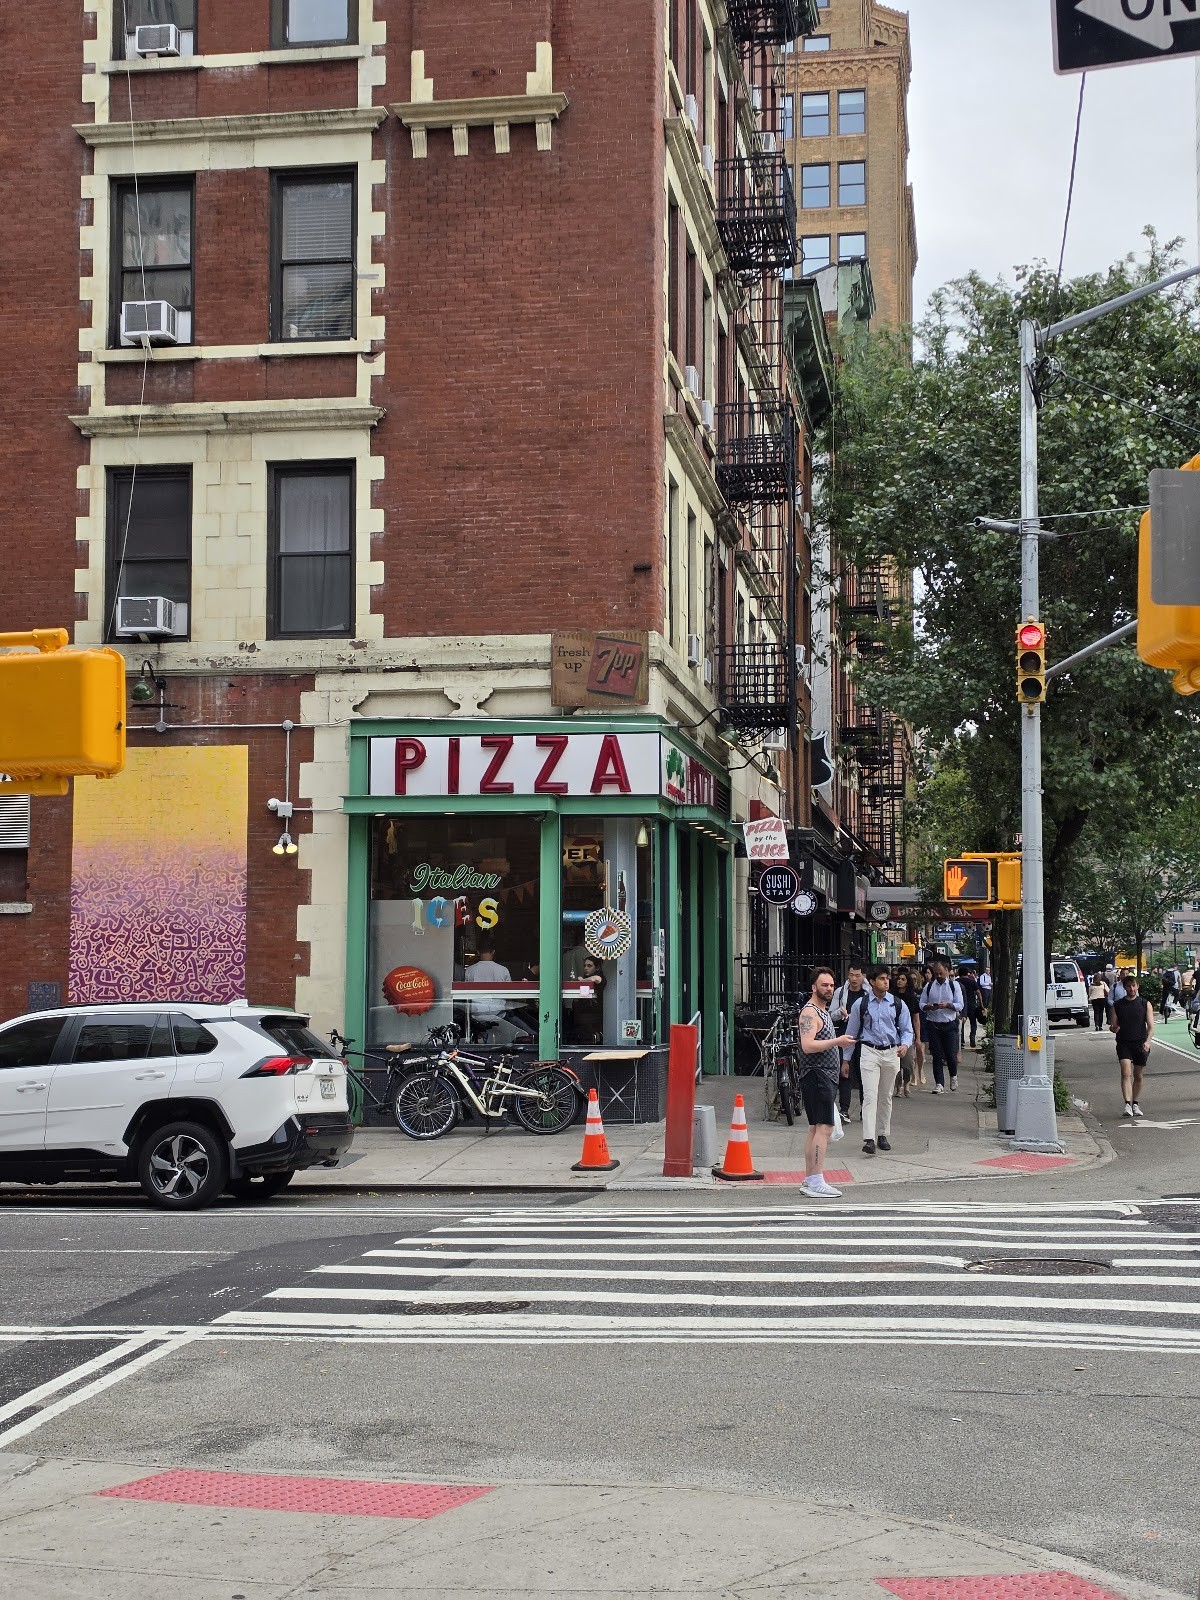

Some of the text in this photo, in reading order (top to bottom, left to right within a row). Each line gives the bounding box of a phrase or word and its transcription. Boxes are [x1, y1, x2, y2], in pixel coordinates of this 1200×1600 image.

[394, 735, 631, 795] PIZZA
[745, 820, 783, 836] PIZZA
[749, 843, 786, 858] SLICE
[409, 863, 501, 892] Italian
[766, 875, 791, 889] SUSHI
[411, 896, 500, 930] ICES
